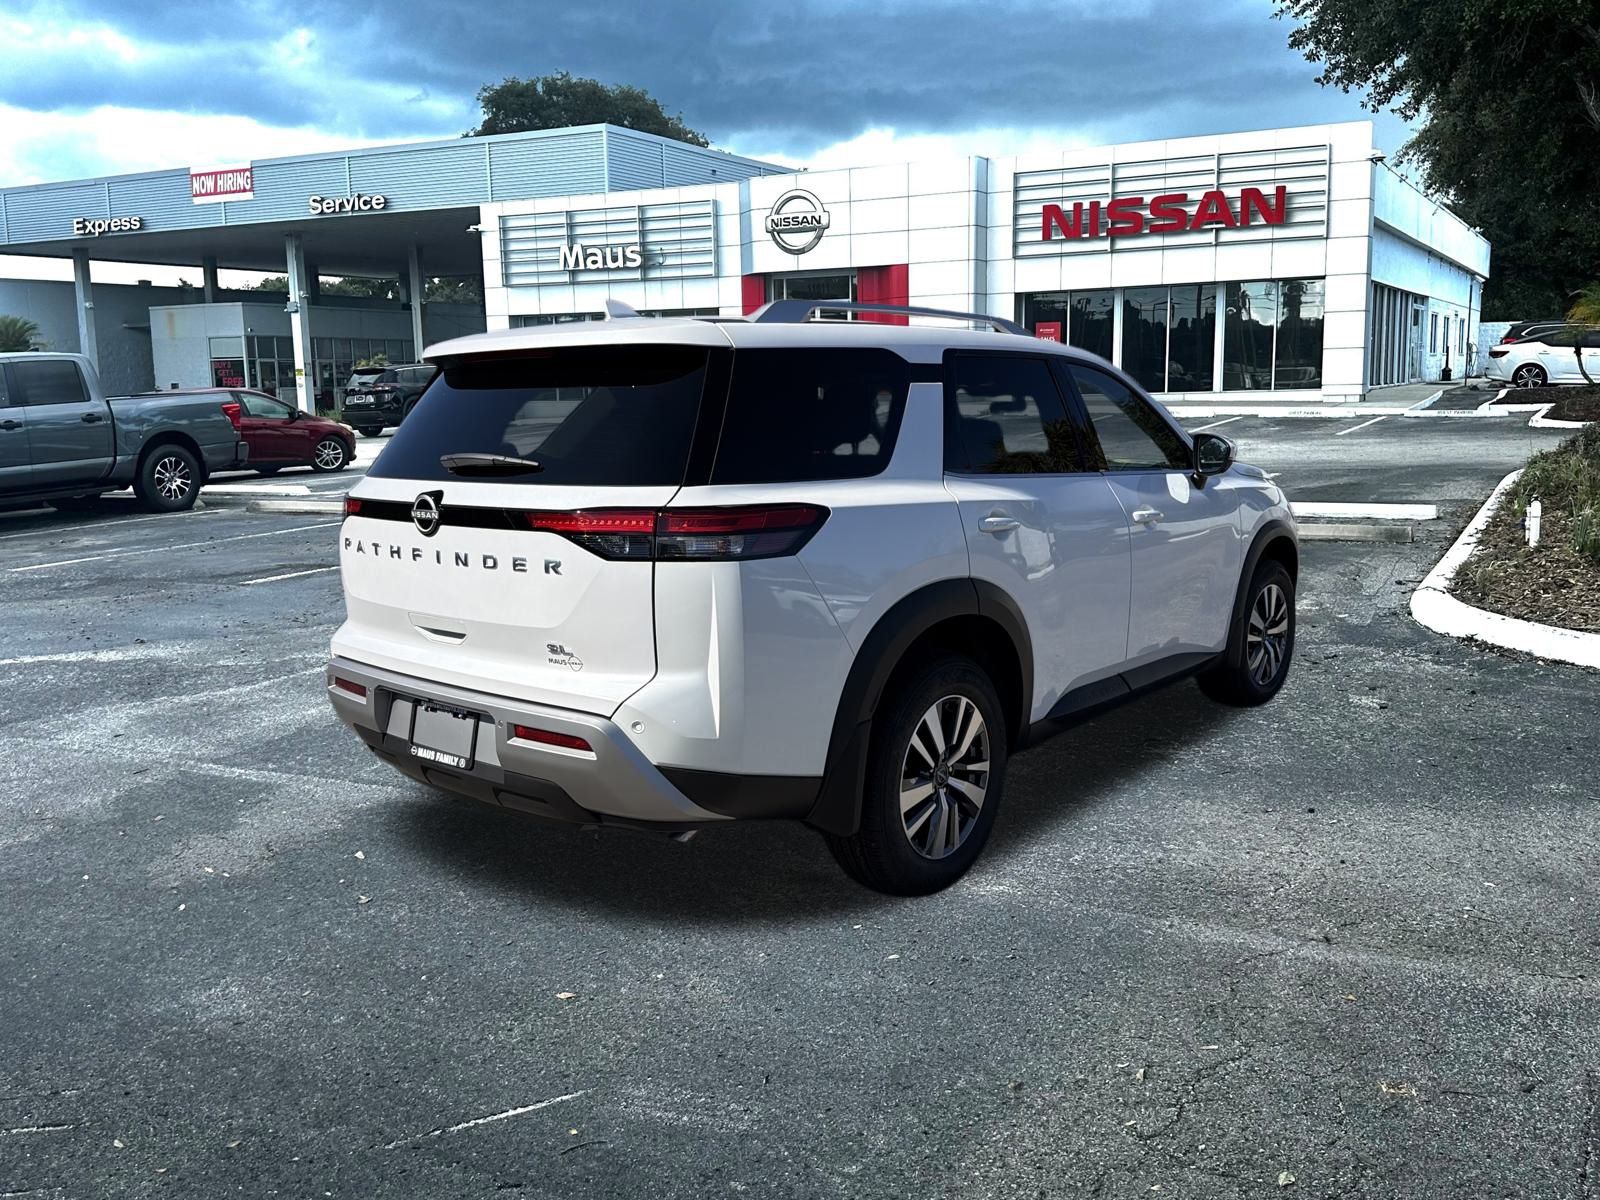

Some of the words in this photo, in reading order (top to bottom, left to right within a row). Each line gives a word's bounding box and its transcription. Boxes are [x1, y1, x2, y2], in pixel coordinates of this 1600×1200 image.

[192, 174, 215, 195] NOW
[217, 171, 251, 192] HIRING
[308, 193, 386, 215] Service
[1042, 185, 1287, 241] NISSAN
[73, 216, 142, 237] Express
[770, 215, 822, 229] NISSAN
[559, 243, 642, 270] Maus
[223, 377, 244, 387] FREE
[344, 537, 563, 576] PATHFINDER
[546, 643, 574, 657] SL
[548, 658, 567, 666] MAUS
[417, 747, 436, 761] MAUS
[435, 752, 460, 767] FAMILY
